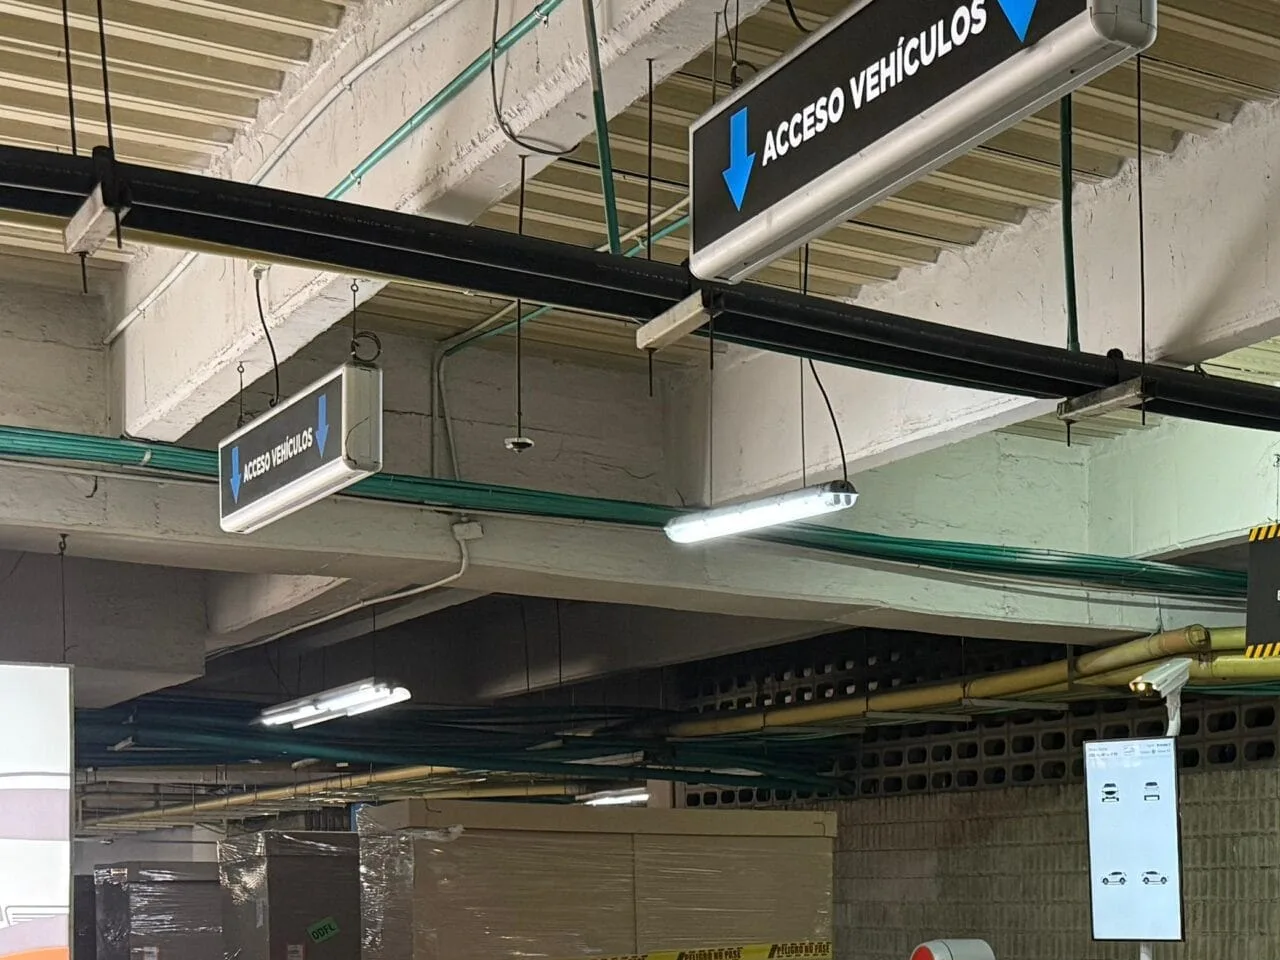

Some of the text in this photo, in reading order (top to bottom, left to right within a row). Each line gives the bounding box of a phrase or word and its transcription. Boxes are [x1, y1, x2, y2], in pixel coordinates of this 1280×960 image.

[761, 0, 987, 167] ACCESO VEHÍCULOS
[243, 427, 313, 483] ACCESO VEHÍCULOS
